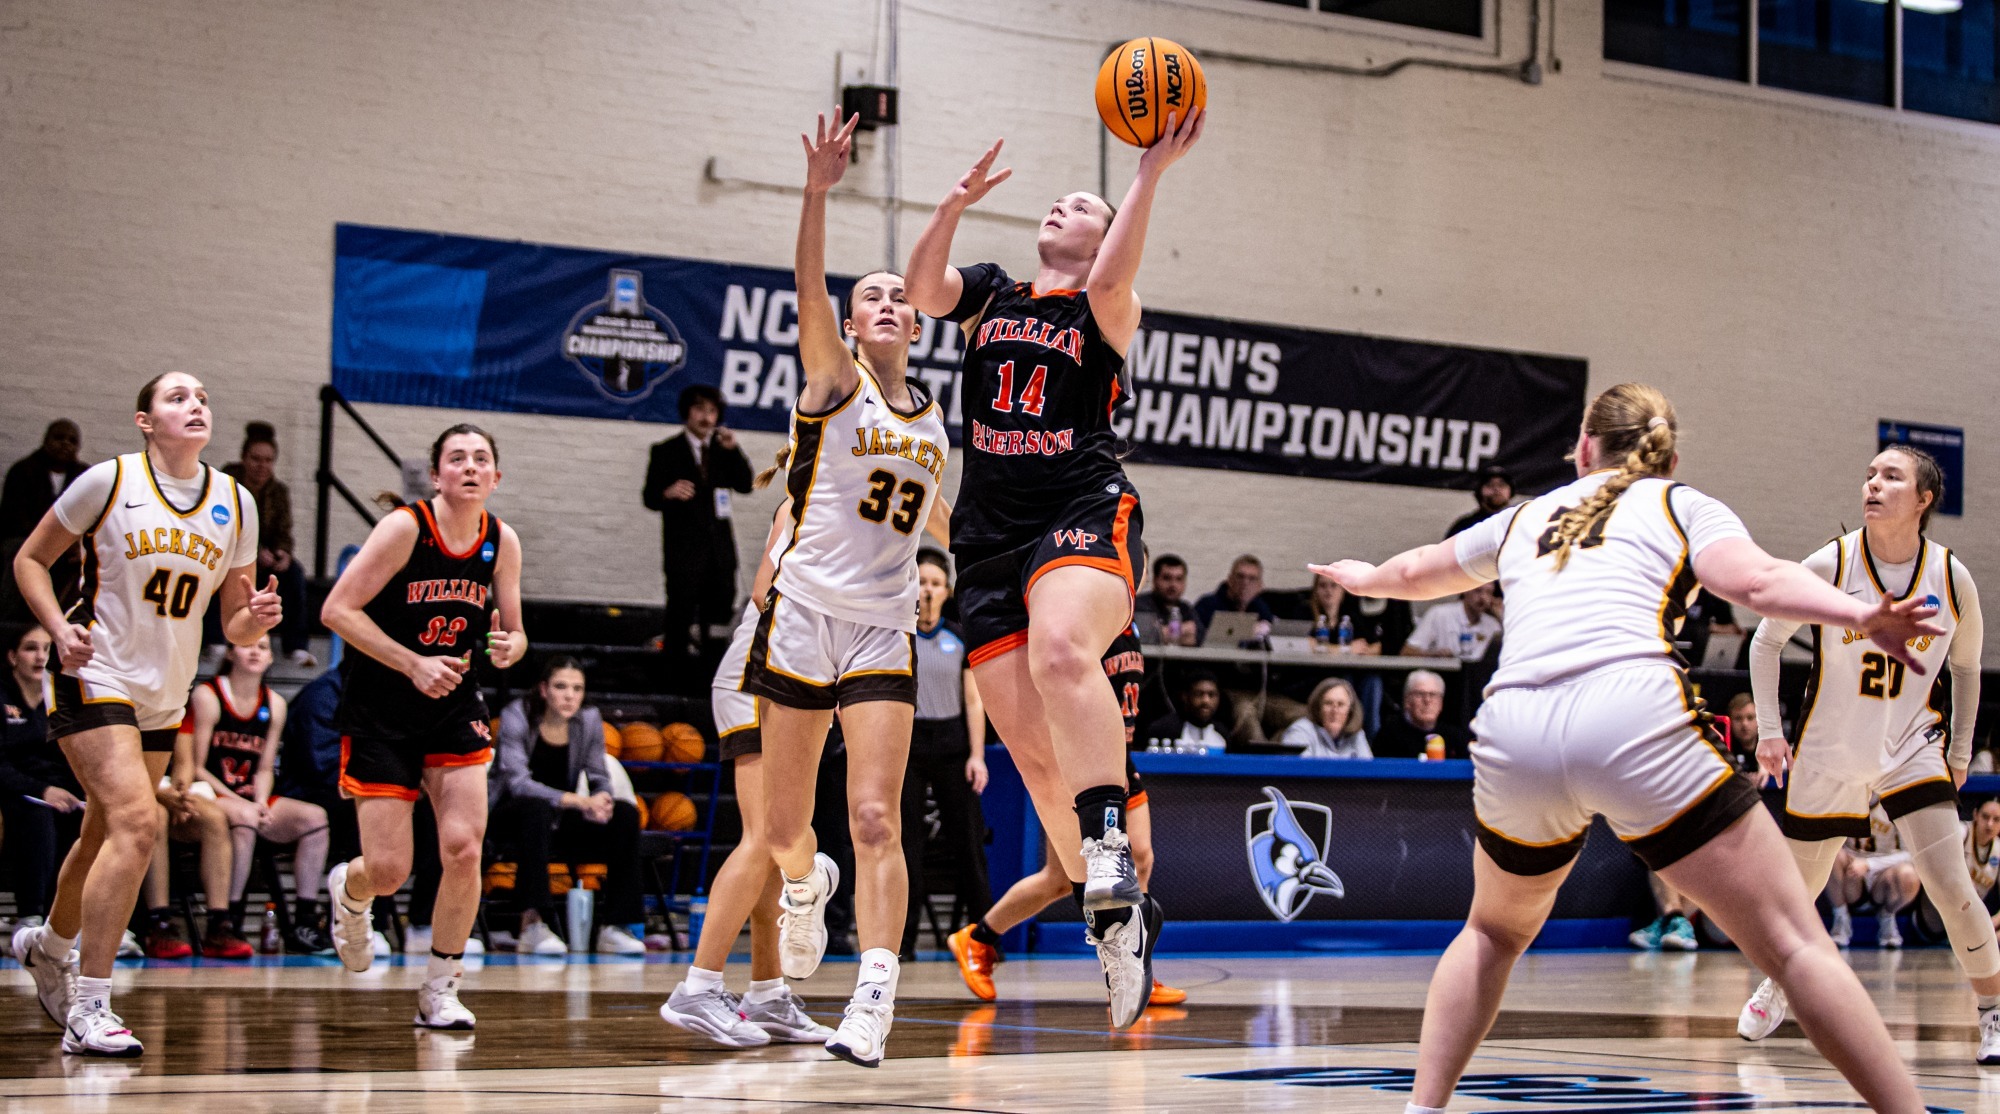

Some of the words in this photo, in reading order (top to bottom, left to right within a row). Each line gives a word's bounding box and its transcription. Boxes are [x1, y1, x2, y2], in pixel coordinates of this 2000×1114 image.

[1126, 47, 1148, 120] Wilson
[1163, 53, 1183, 107] NCAA
[992, 360, 1048, 417] 14
[1126, 328, 1281, 395] MEN'S
[851, 427, 946, 484] JACKETS
[1111, 386, 1501, 472] CHAMPIONSHIP
[857, 467, 927, 536] 33
[125, 527, 224, 571] JACKETS
[1053, 528, 1098, 551] WP
[143, 566, 200, 620] 40
[1104, 651, 1144, 677] WILL
[1859, 650, 1907, 700] 20
